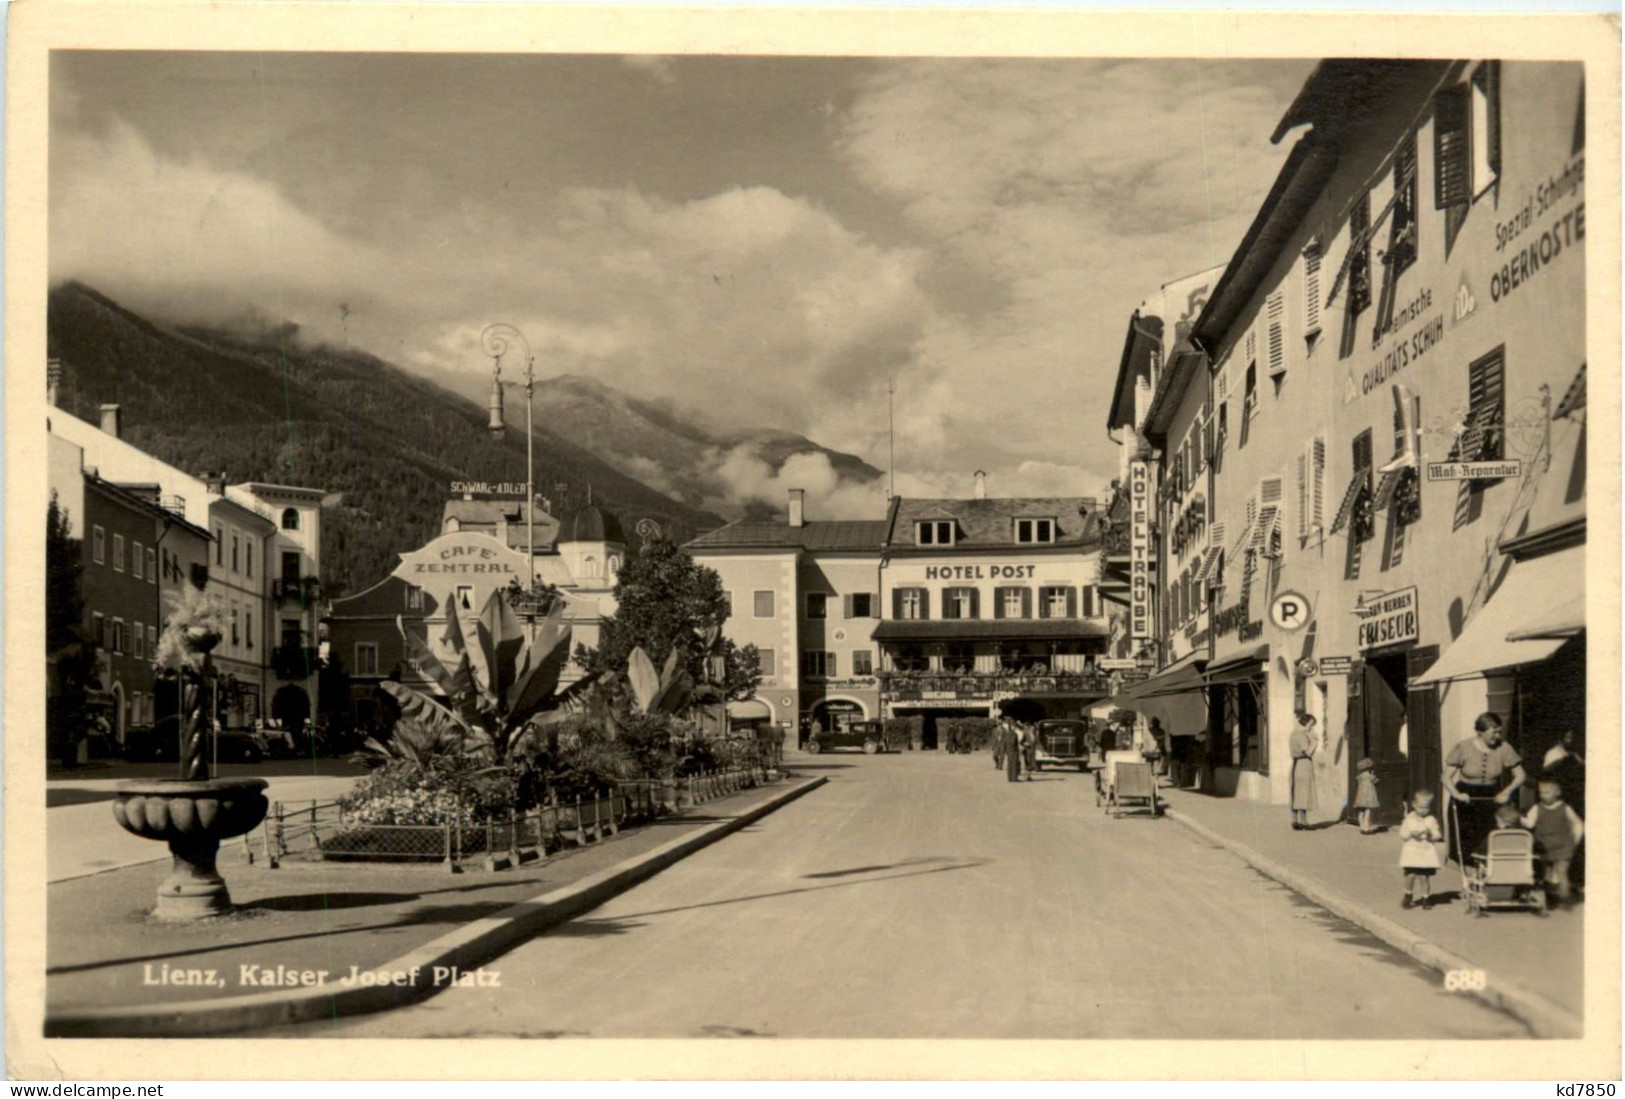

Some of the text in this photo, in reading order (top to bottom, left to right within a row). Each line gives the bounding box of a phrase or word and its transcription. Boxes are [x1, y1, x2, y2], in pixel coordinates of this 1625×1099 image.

[1413, 313, 1443, 361] SCHUH
[1133, 466, 1146, 632] HOTEL TRAUBE
[414, 563, 515, 573] ZENTRAL
[926, 564, 1036, 580] HOTEL POST
[1281, 601, 1299, 622] P
[1358, 610, 1415, 647] FRISEUR
